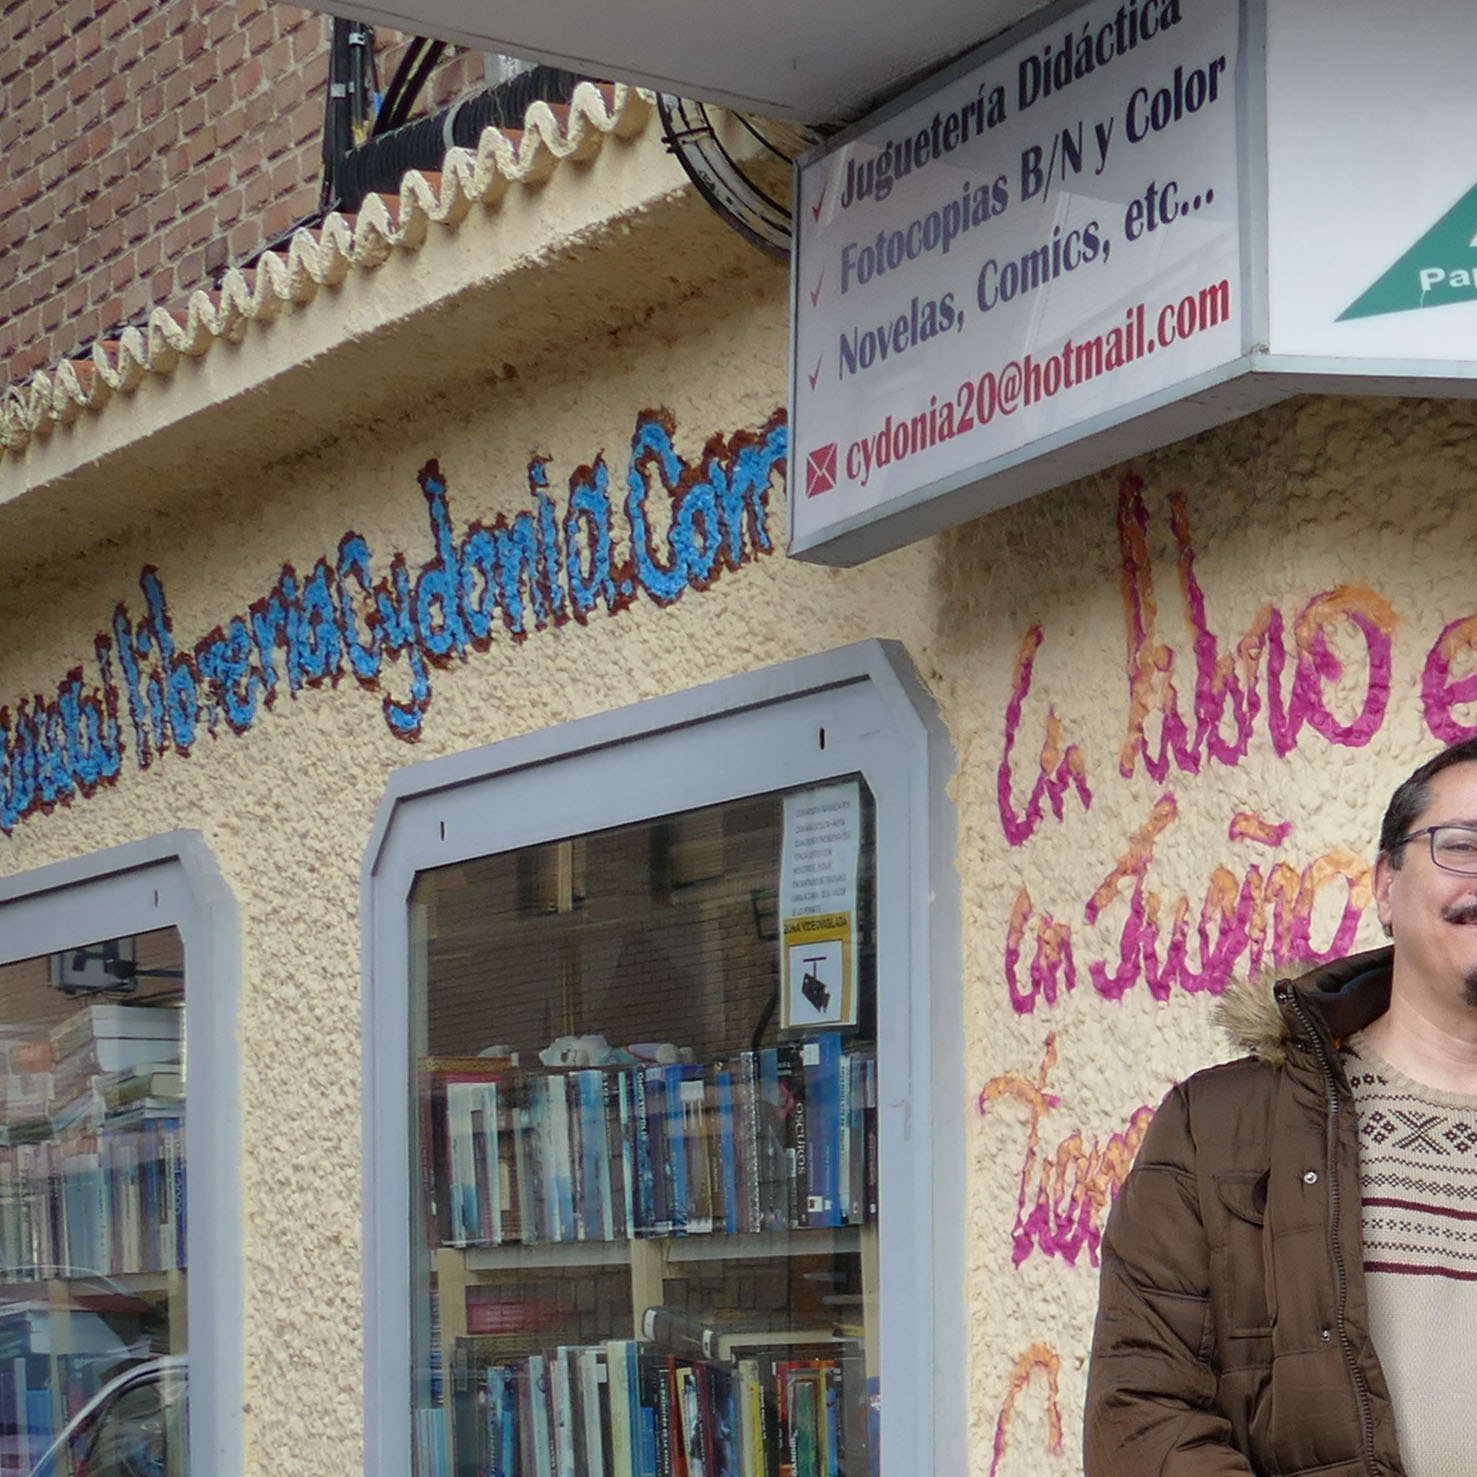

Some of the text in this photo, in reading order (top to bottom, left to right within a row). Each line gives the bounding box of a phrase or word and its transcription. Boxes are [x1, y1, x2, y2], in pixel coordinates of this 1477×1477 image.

[840, 0, 1182, 210] Juguetería Didáctica
[840, 56, 1227, 295] Fotocopias B/N y Color
[838, 181, 1216, 381] Novelas, Comics, etc...
[845, 279, 1231, 487] cydonia20@hotmail.com
